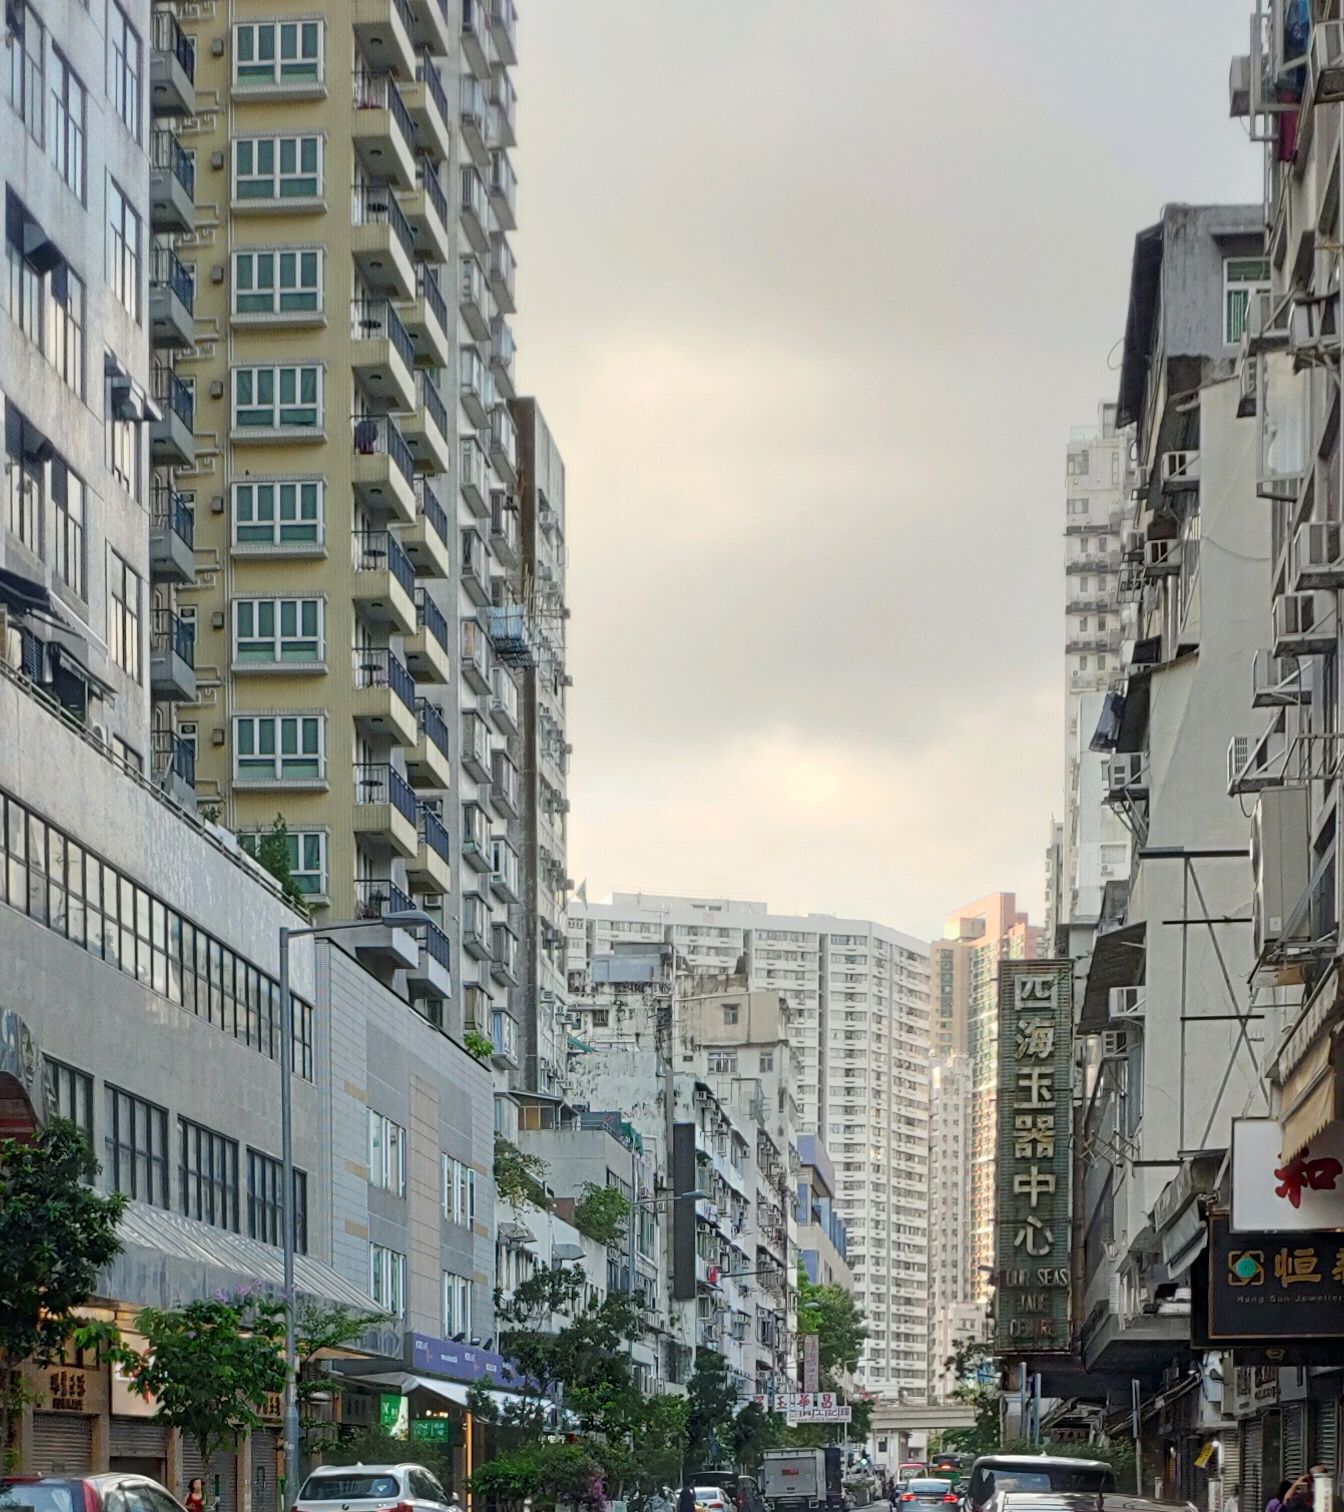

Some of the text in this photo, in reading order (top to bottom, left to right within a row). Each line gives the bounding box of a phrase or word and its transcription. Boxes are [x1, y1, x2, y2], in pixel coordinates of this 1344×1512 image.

[1013, 974, 1056, 1257] 四海玉器中心
